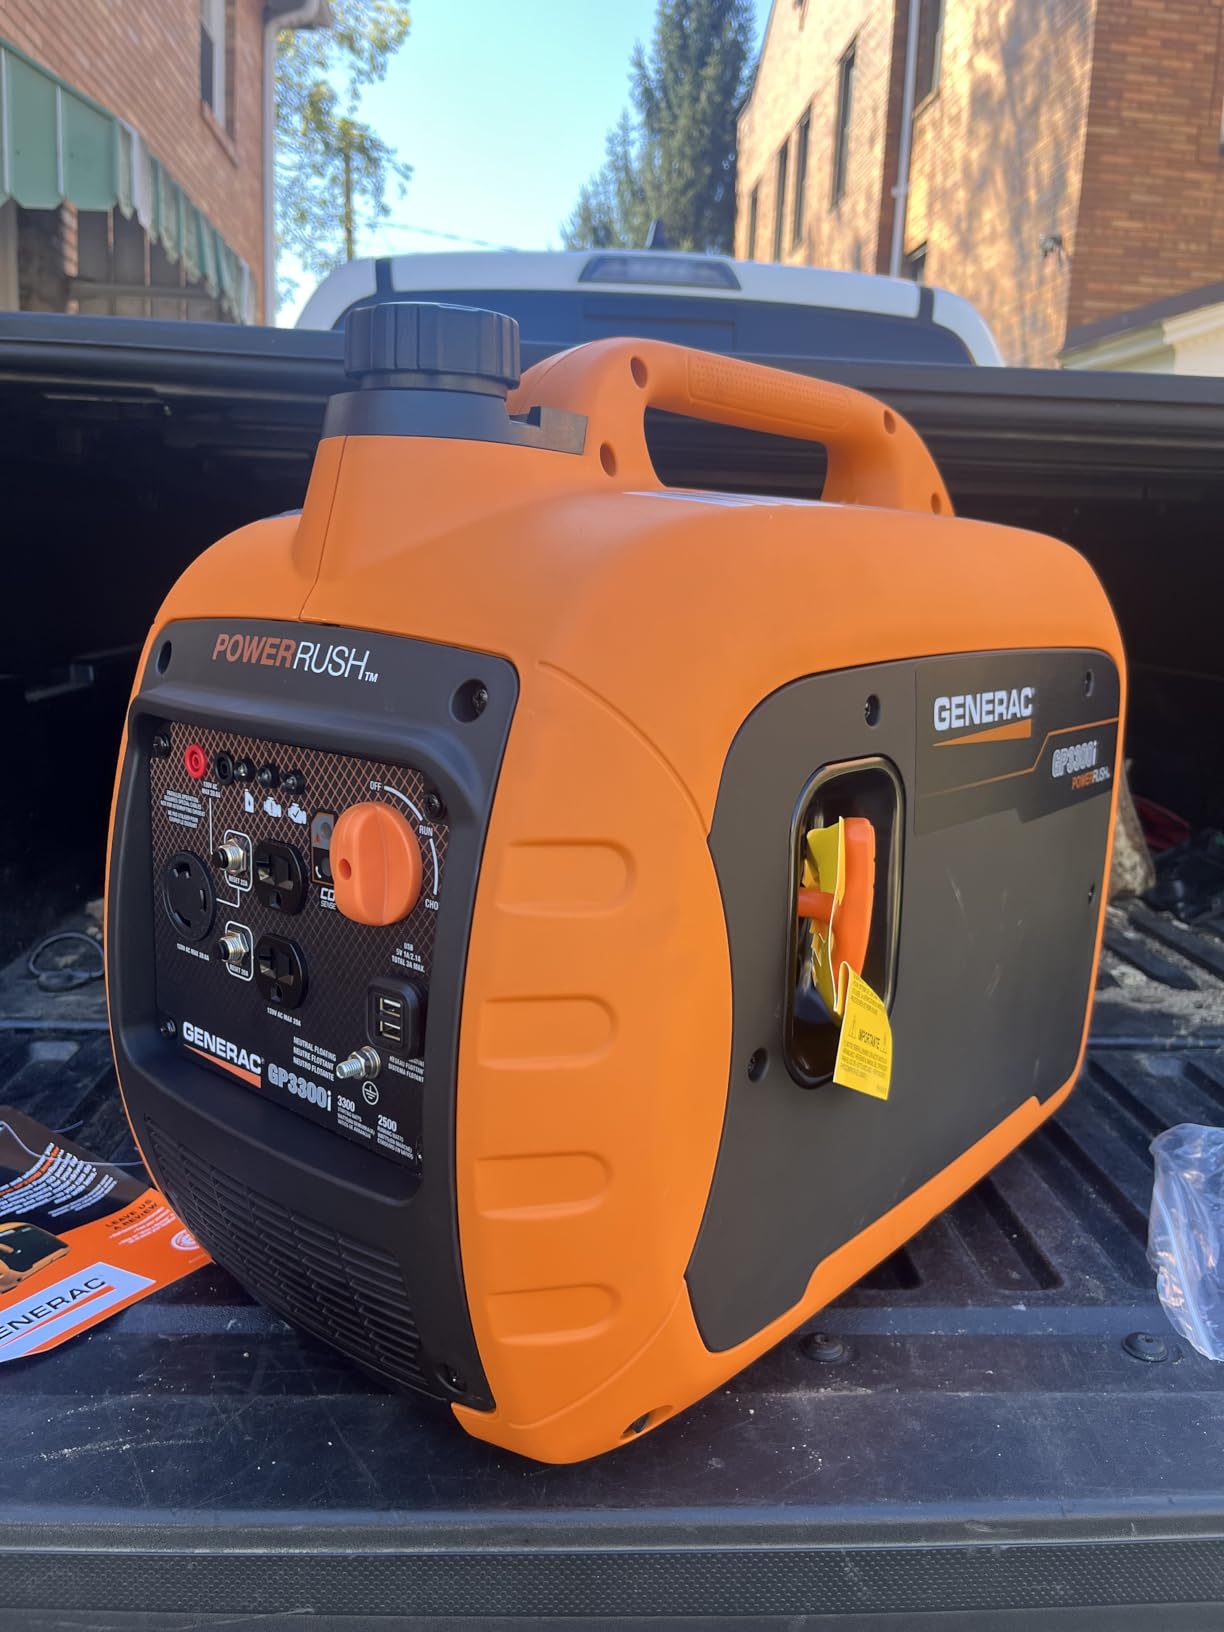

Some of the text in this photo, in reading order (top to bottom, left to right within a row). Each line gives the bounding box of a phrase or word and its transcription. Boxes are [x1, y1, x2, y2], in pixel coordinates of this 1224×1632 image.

[933, 687, 1033, 731] GENERAC
[369, 781, 382, 791] OFF
[419, 825, 433, 837] RUN
[424, 898, 439, 911] CHO
[183, 1021, 262, 1074] GENERAC
[267, 1063, 332, 1112] GP3300i
[337, 1095, 355, 1113] 3300
[377, 1114, 397, 1132] 2500
[0, 1277, 106, 1340] ENERAC
